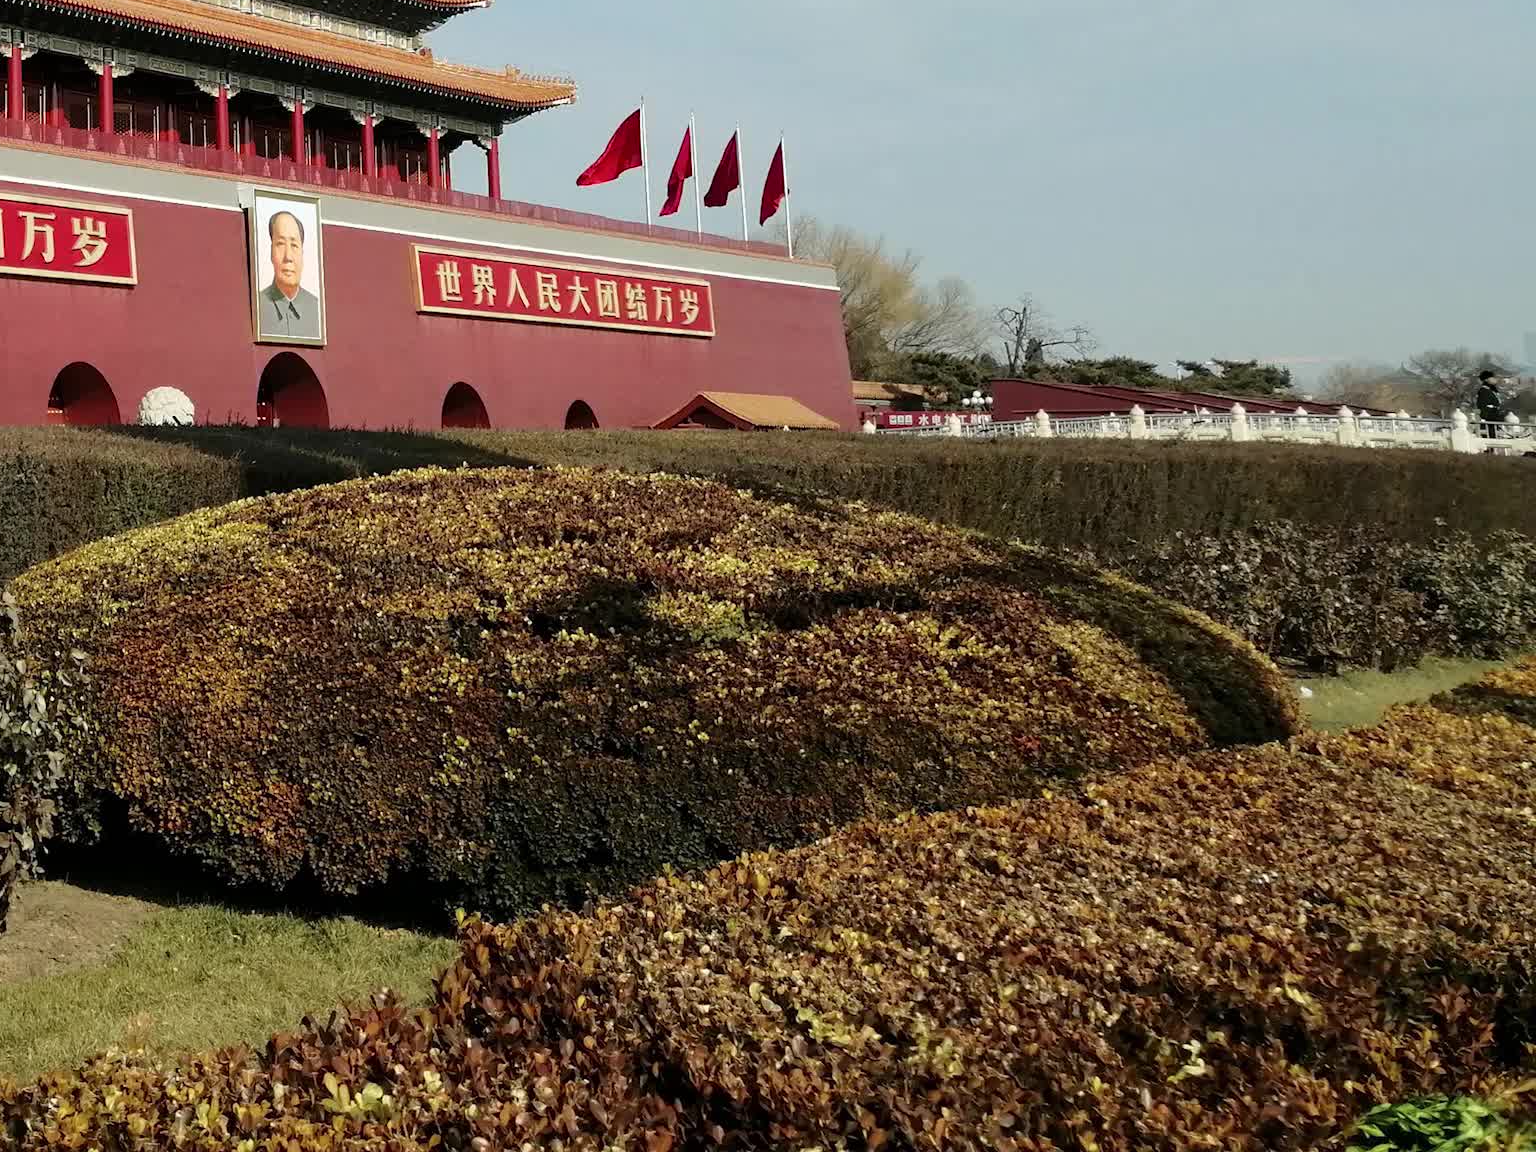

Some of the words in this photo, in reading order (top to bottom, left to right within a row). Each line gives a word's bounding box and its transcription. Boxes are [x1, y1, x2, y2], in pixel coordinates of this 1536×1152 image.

[435, 260, 700, 325] 世界人民大团结万岁
